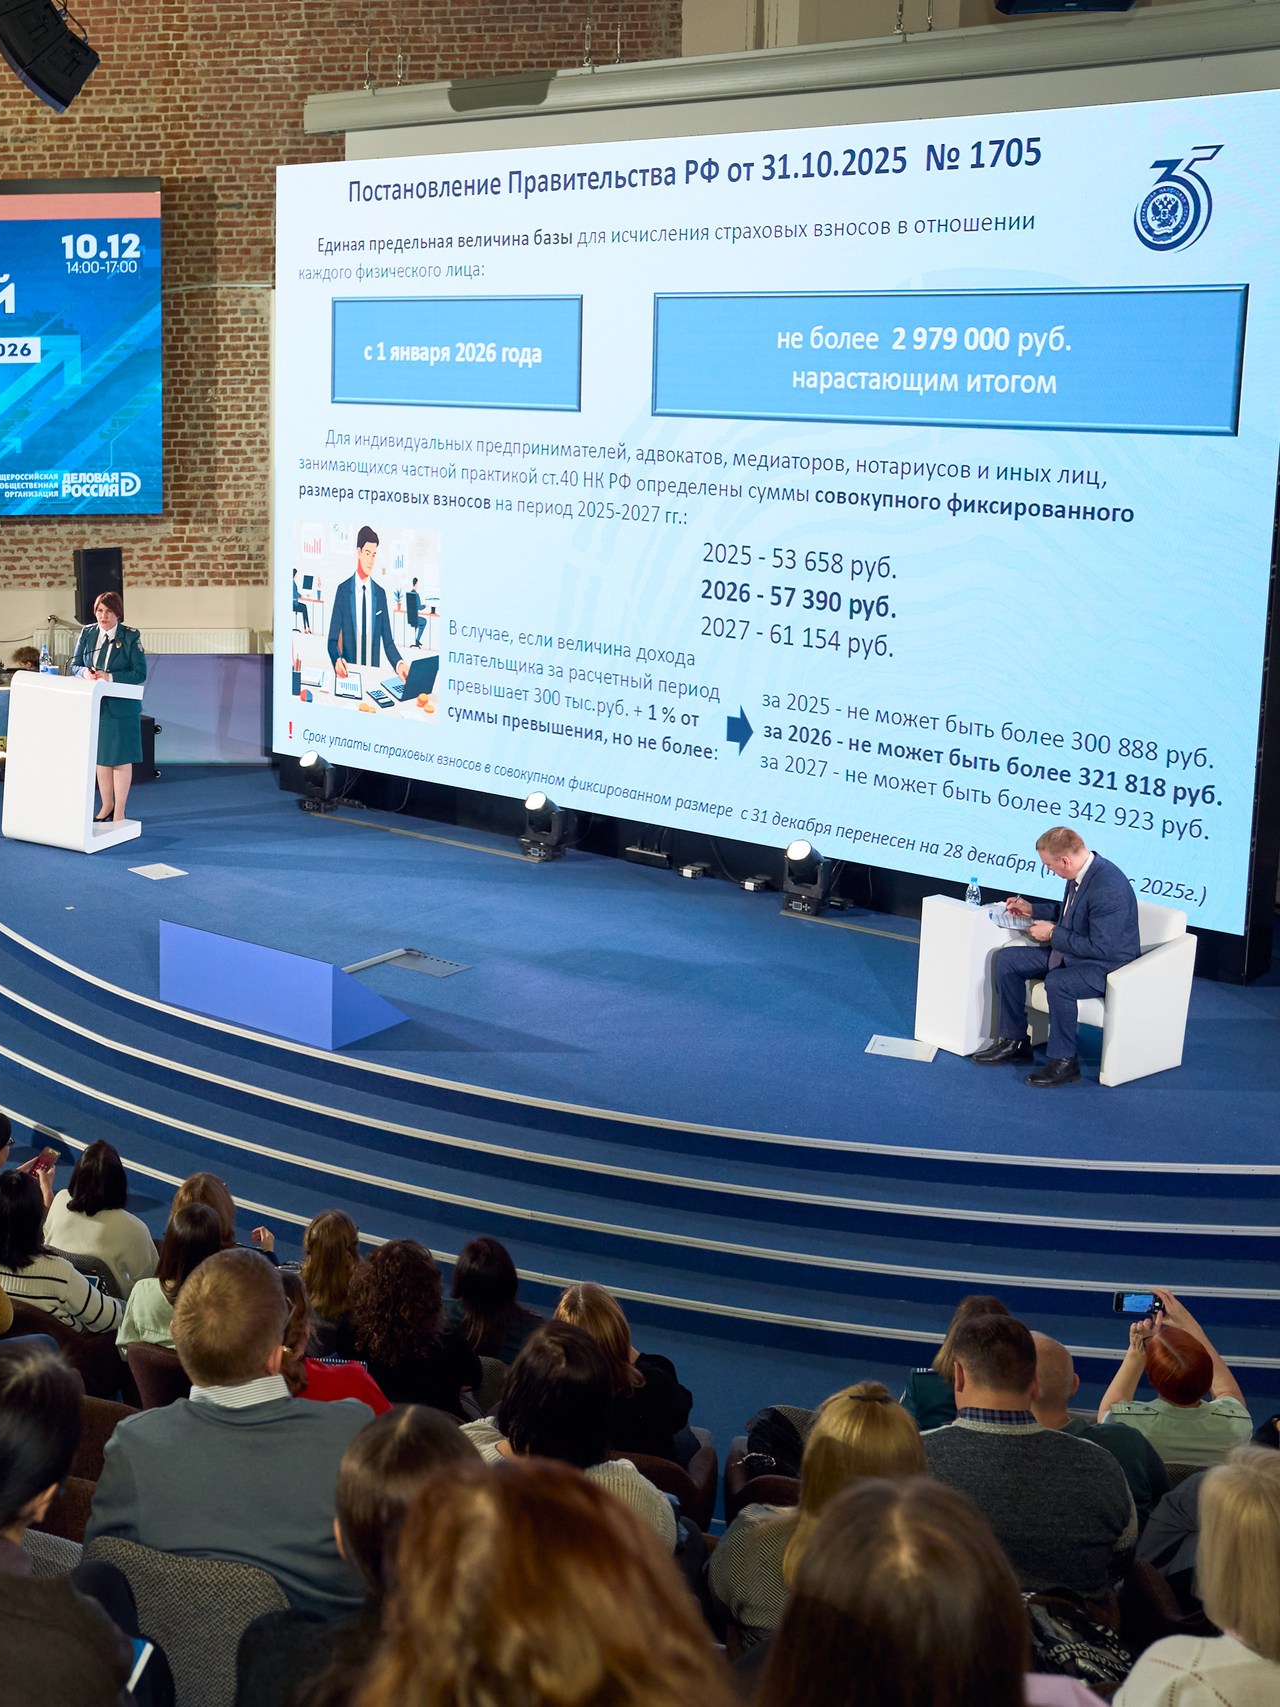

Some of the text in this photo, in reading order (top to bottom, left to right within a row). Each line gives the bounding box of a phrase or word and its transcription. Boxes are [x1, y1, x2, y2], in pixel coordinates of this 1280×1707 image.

[350, 137, 1041, 202] Постановление Правительства РФ от 31.10.2025 № 1705
[62, 233, 140, 259] 10.12
[319, 215, 1034, 256] Единая предельная величина базы для исчисления страховых взносов в отношении
[66, 261, 137, 274] 14:00-17:00
[299, 263, 484, 283] каждого физического лица:
[364, 341, 542, 368] с 1 января 2026 года
[778, 324, 1071, 357] не более 2 979 000 руб.
[793, 371, 1056, 395] нарастающим итогом
[62, 472, 119, 484] ДЕЛОВАЯ
[326, 430, 1106, 490] Для индивидуальных предпринимателей, адвокатов, медиаторов, нотариусов и иных лиц,
[0, 482, 59, 490] ОБЩЕСТВЕННАЯ
[4, 490, 59, 498] ОРГАНИЗАЦИЯ
[62, 484, 119, 497] РОССИЯ
[300, 459, 1134, 523] занимающихся частной практикой ст.40 НК РФ определены суммы совокупного фиксированного
[300, 484, 686, 525] размера страховых взносов на период 2025-2027 гг.:
[702, 579, 895, 621] 2026 57 390 руб.
[450, 620, 694, 669] В случае, если величина дохода
[449, 651, 720, 704] плательщика за расчетный период
[449, 678, 699, 727] превышает 300 тыс.руб. 1 от
[448, 706, 717, 761] суммы превышения, но не более:
[303, 728, 733, 819] Срок уплаты страховых взносов в совокупном фиксированном размере
[764, 724, 1222, 808] за 2026 не может быть более 321 818 руб.
[741, 809, 748, 820] с
[751, 808, 767, 824] 31
[772, 811, 831, 837] декабря
[836, 826, 915, 850] перенесен
[920, 841, 939, 855] на
[943, 842, 963, 859] 28
[967, 846, 1036, 876] декабря
[1140, 877, 1207, 907] 2025г.)
